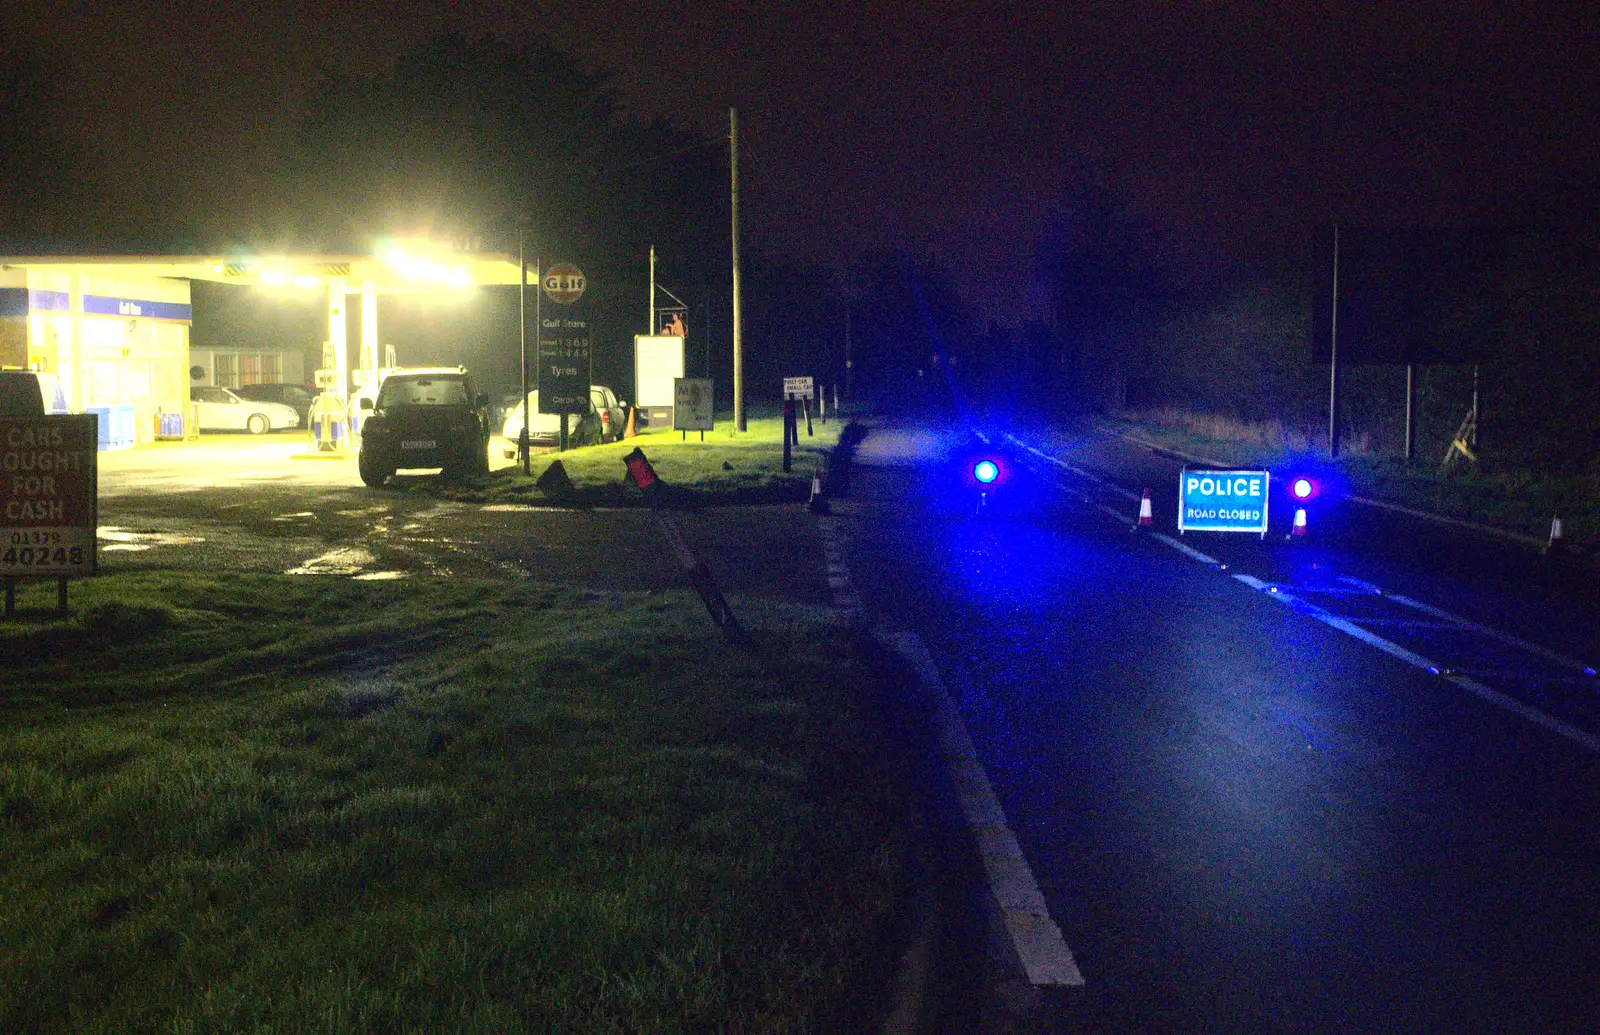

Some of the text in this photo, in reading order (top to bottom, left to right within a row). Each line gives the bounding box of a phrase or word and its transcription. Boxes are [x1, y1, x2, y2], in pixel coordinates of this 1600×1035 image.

[546, 278, 582, 289] Gulf
[542, 319, 586, 328] Gulf Store
[551, 366, 578, 377] Tyres
[7, 427, 63, 447] CARS
[2, 451, 83, 471] OUGHT
[12, 476, 56, 496] FOR
[1187, 477, 1260, 497] POLICE
[6, 500, 64, 520] CASH
[1187, 508, 1260, 521] ROAD CLOSED
[11, 531, 61, 545] 01379
[2, 546, 83, 566] 40248
